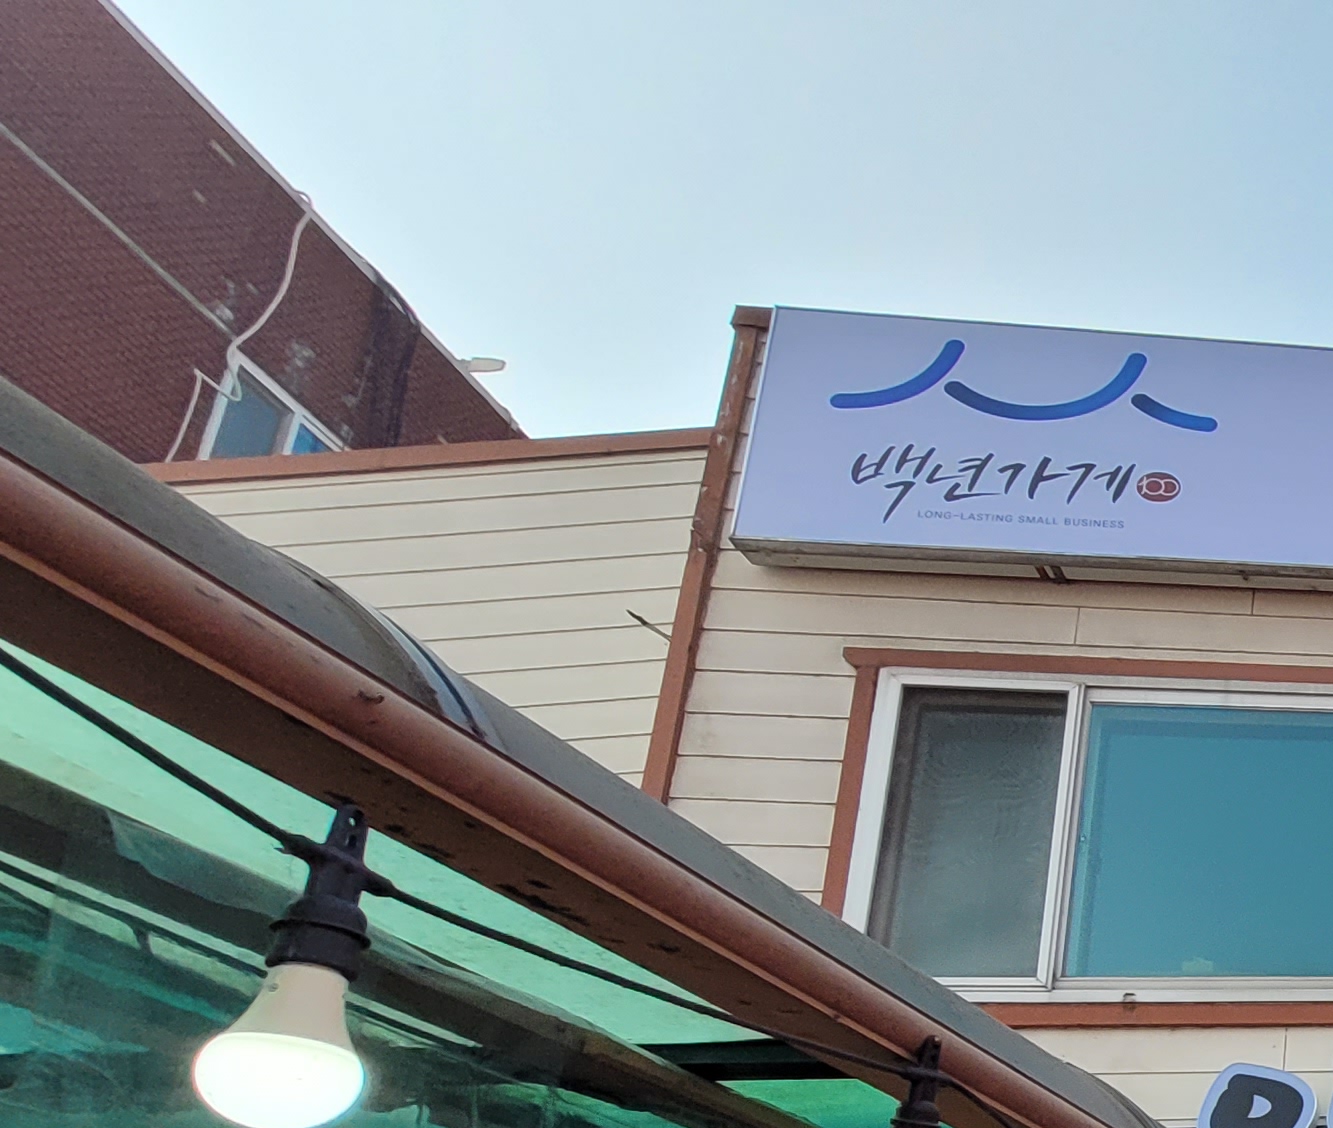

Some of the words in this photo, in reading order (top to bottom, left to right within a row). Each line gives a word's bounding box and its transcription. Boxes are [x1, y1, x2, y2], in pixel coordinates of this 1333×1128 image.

[850, 442, 1136, 524] 백년가게
[917, 509, 1014, 524] LONG-LASTING
[1017, 515, 1058, 526] SMALL
[1063, 517, 1125, 529] BUSINESS
